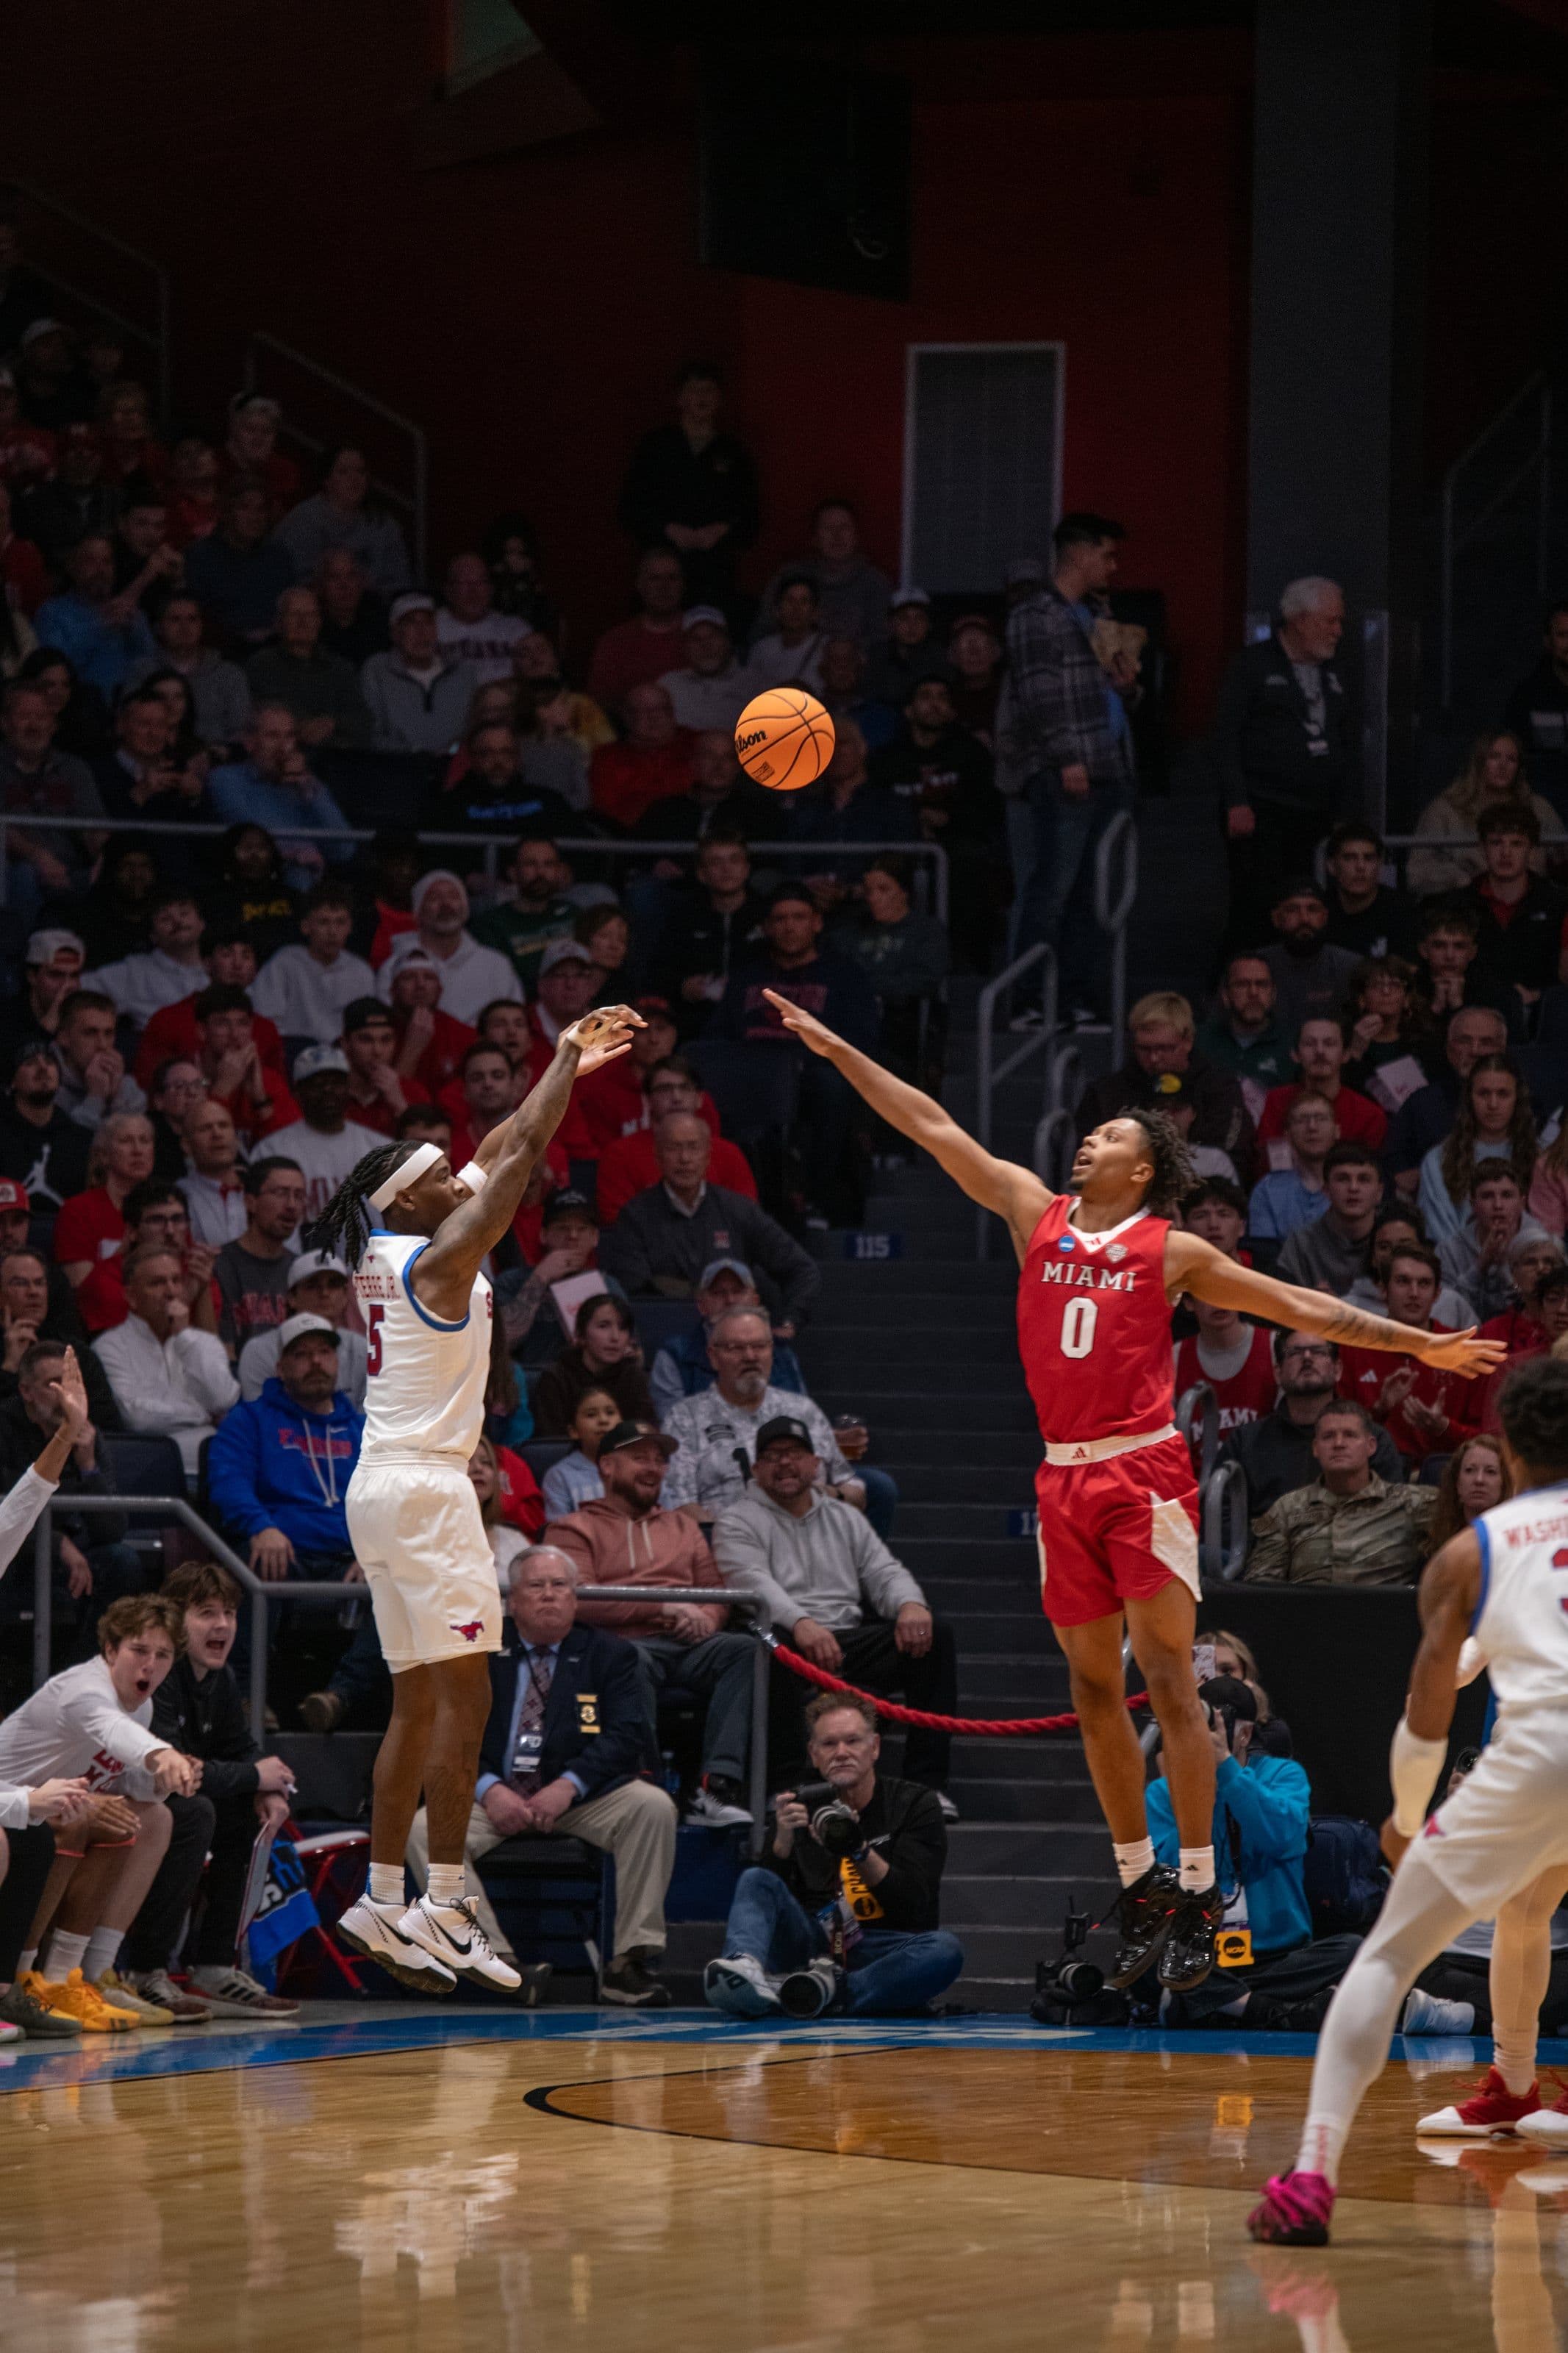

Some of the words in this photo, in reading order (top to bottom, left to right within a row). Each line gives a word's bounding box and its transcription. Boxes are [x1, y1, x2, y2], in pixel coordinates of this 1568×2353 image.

[855, 1235, 890, 1260] 115
[1040, 1260, 1138, 1293] MIAMI
[367, 1304, 384, 1377] 5
[1059, 1296, 1099, 1360] 0
[1191, 1406, 1259, 1443] MAMI
[1020, 1511, 1039, 1536] 11
